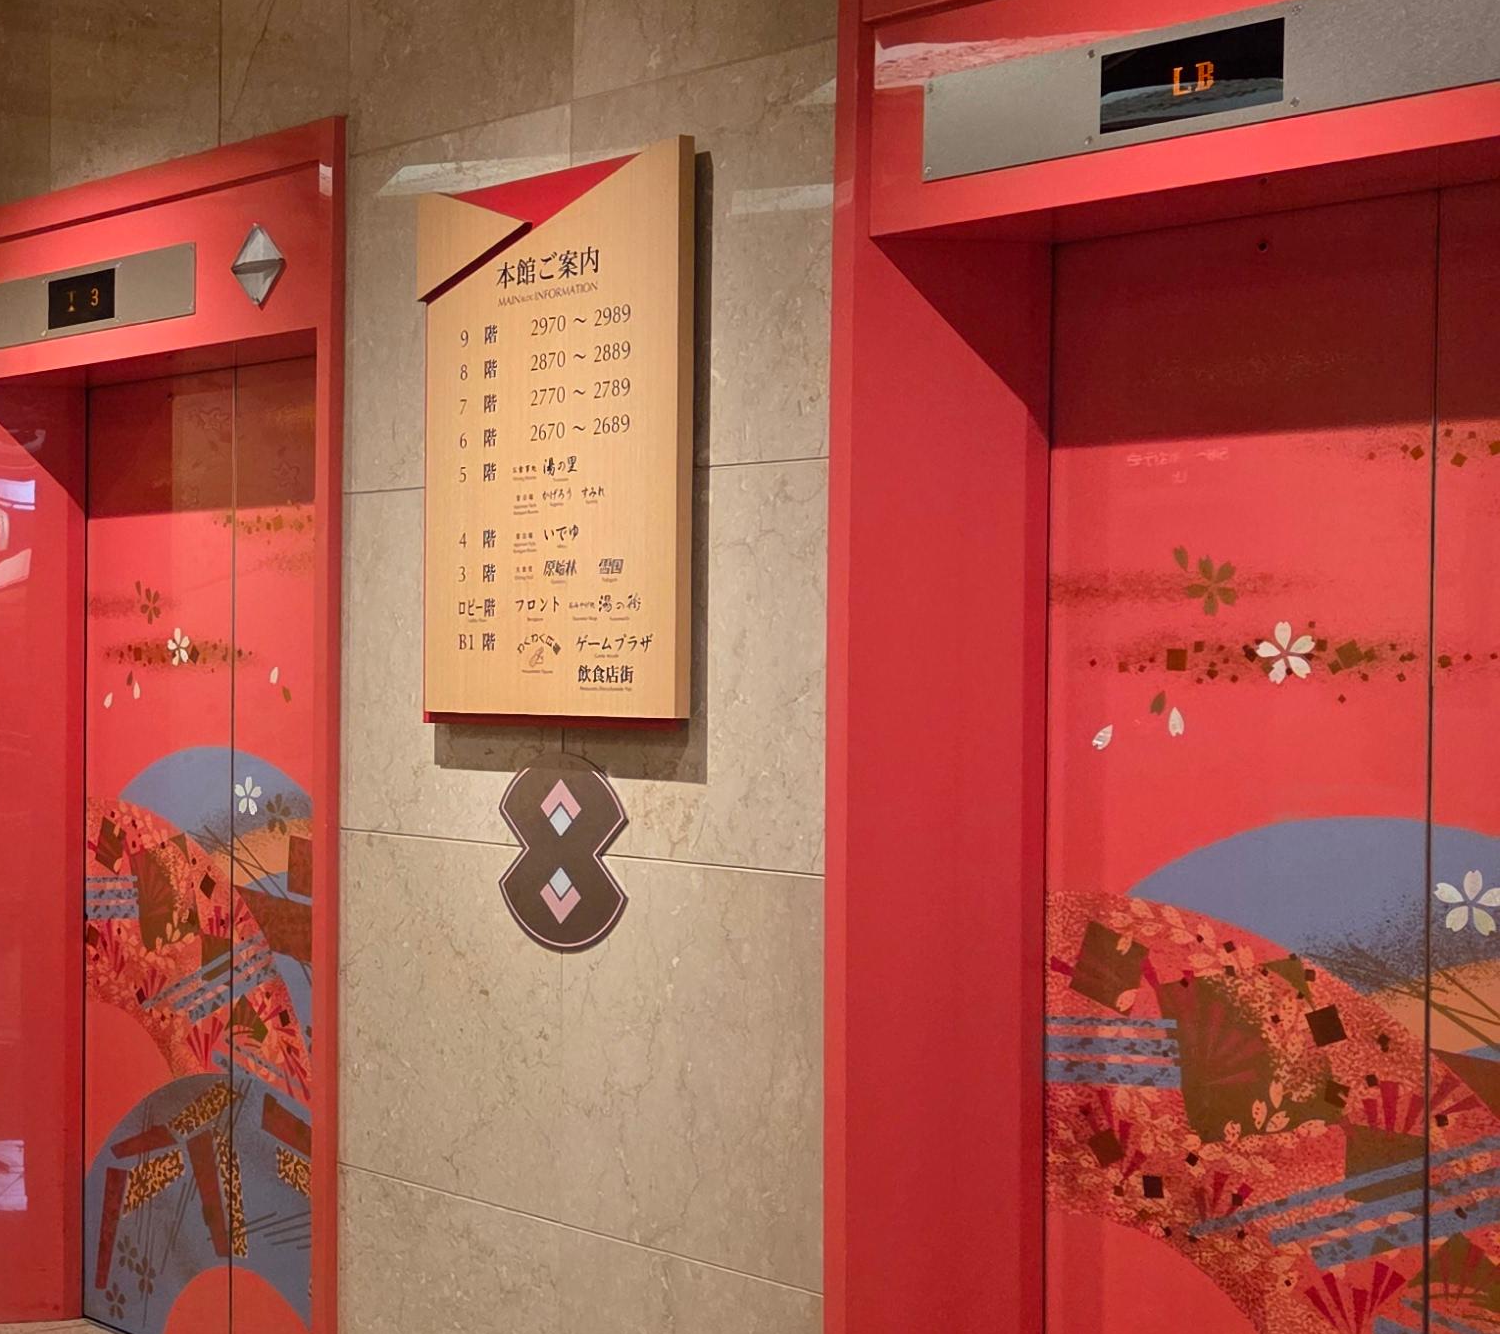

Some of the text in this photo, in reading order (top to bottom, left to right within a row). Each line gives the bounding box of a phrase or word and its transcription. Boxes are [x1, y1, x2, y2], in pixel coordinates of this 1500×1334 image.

[1173, 61, 1214, 96] LB
[496, 246, 600, 290] 本館ご案内
[91, 288, 99, 306] 3
[498, 295, 521, 307] MAIN
[535, 281, 598, 302] INFORMATION
[460, 329, 469, 348] 9
[484, 324, 498, 345] 階
[531, 315, 566, 336] 2970
[594, 304, 631, 327] 2989
[460, 364, 468, 381] 8
[484, 359, 497, 379] 階
[530, 351, 566, 372] 2870
[594, 341, 631, 363] 2889
[460, 399, 467, 415] 7
[484, 394, 497, 414] 階
[530, 386, 566, 407] 2770
[594, 377, 631, 399] 2789
[460, 432, 468, 449] 6
[483, 428, 497, 448] 階
[530, 422, 565, 442] 2670
[593, 414, 630, 435] 2689
[459, 466, 467, 483] 5
[483, 462, 497, 482] 階
[543, 456, 578, 476] 湯の里
[581, 486, 605, 497] すみれ
[459, 532, 467, 548] 4
[483, 529, 497, 549] 階
[543, 524, 579, 541] いでゆ
[458, 566, 466, 583] 3
[483, 564, 496, 583] 階
[599, 558, 624, 575] 雪国
[459, 598, 496, 617] ロビー階
[515, 596, 560, 613] フロント
[459, 634, 474, 651] B1
[483, 633, 496, 652] 階
[576, 633, 653, 653] ゲームプラザ
[578, 665, 634, 684] 飲食店街
